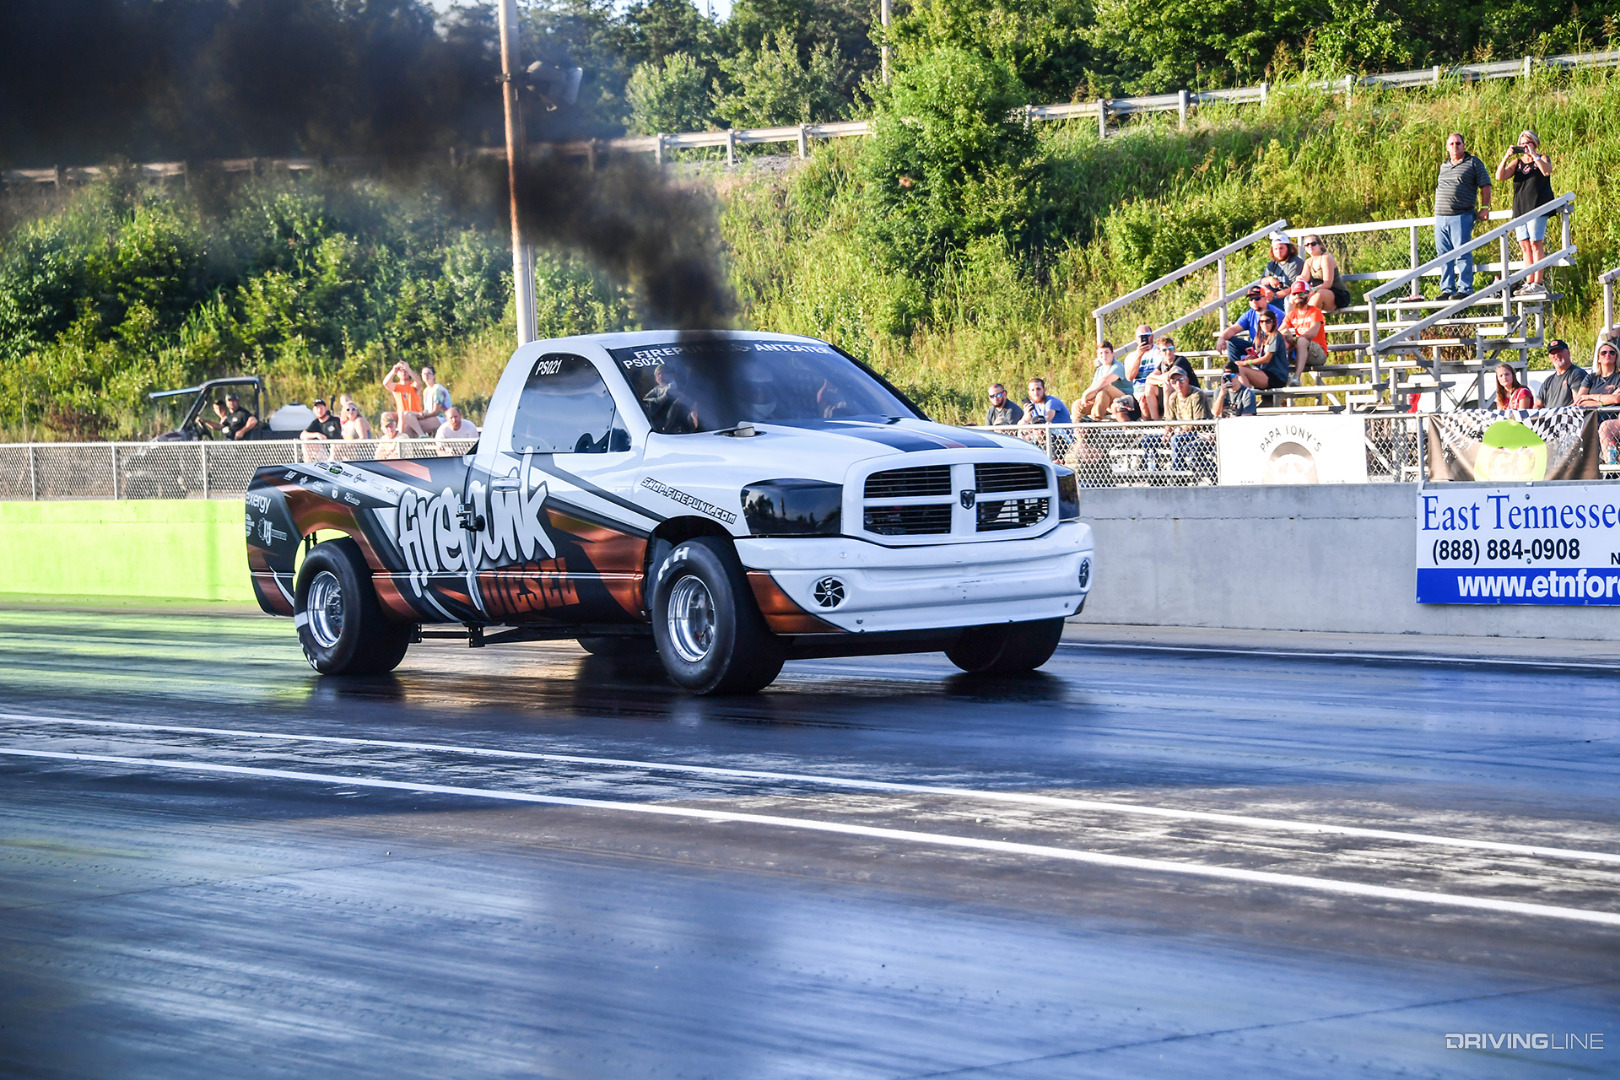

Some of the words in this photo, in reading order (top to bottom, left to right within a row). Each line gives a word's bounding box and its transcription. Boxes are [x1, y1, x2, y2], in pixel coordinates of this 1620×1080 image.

[535, 359, 562, 376] PS021
[623, 356, 665, 370] PS021
[640, 476, 738, 525] SHOP.FIREPUNK.COM
[1422, 494, 1480, 531] East
[1486, 493, 1620, 530] Tennesse
[1432, 538, 1480, 566] (888)
[1487, 538, 1581, 561] 884-0908
[479, 556, 580, 616] DIESEL
[1457, 568, 1620, 598] www.etnfor
